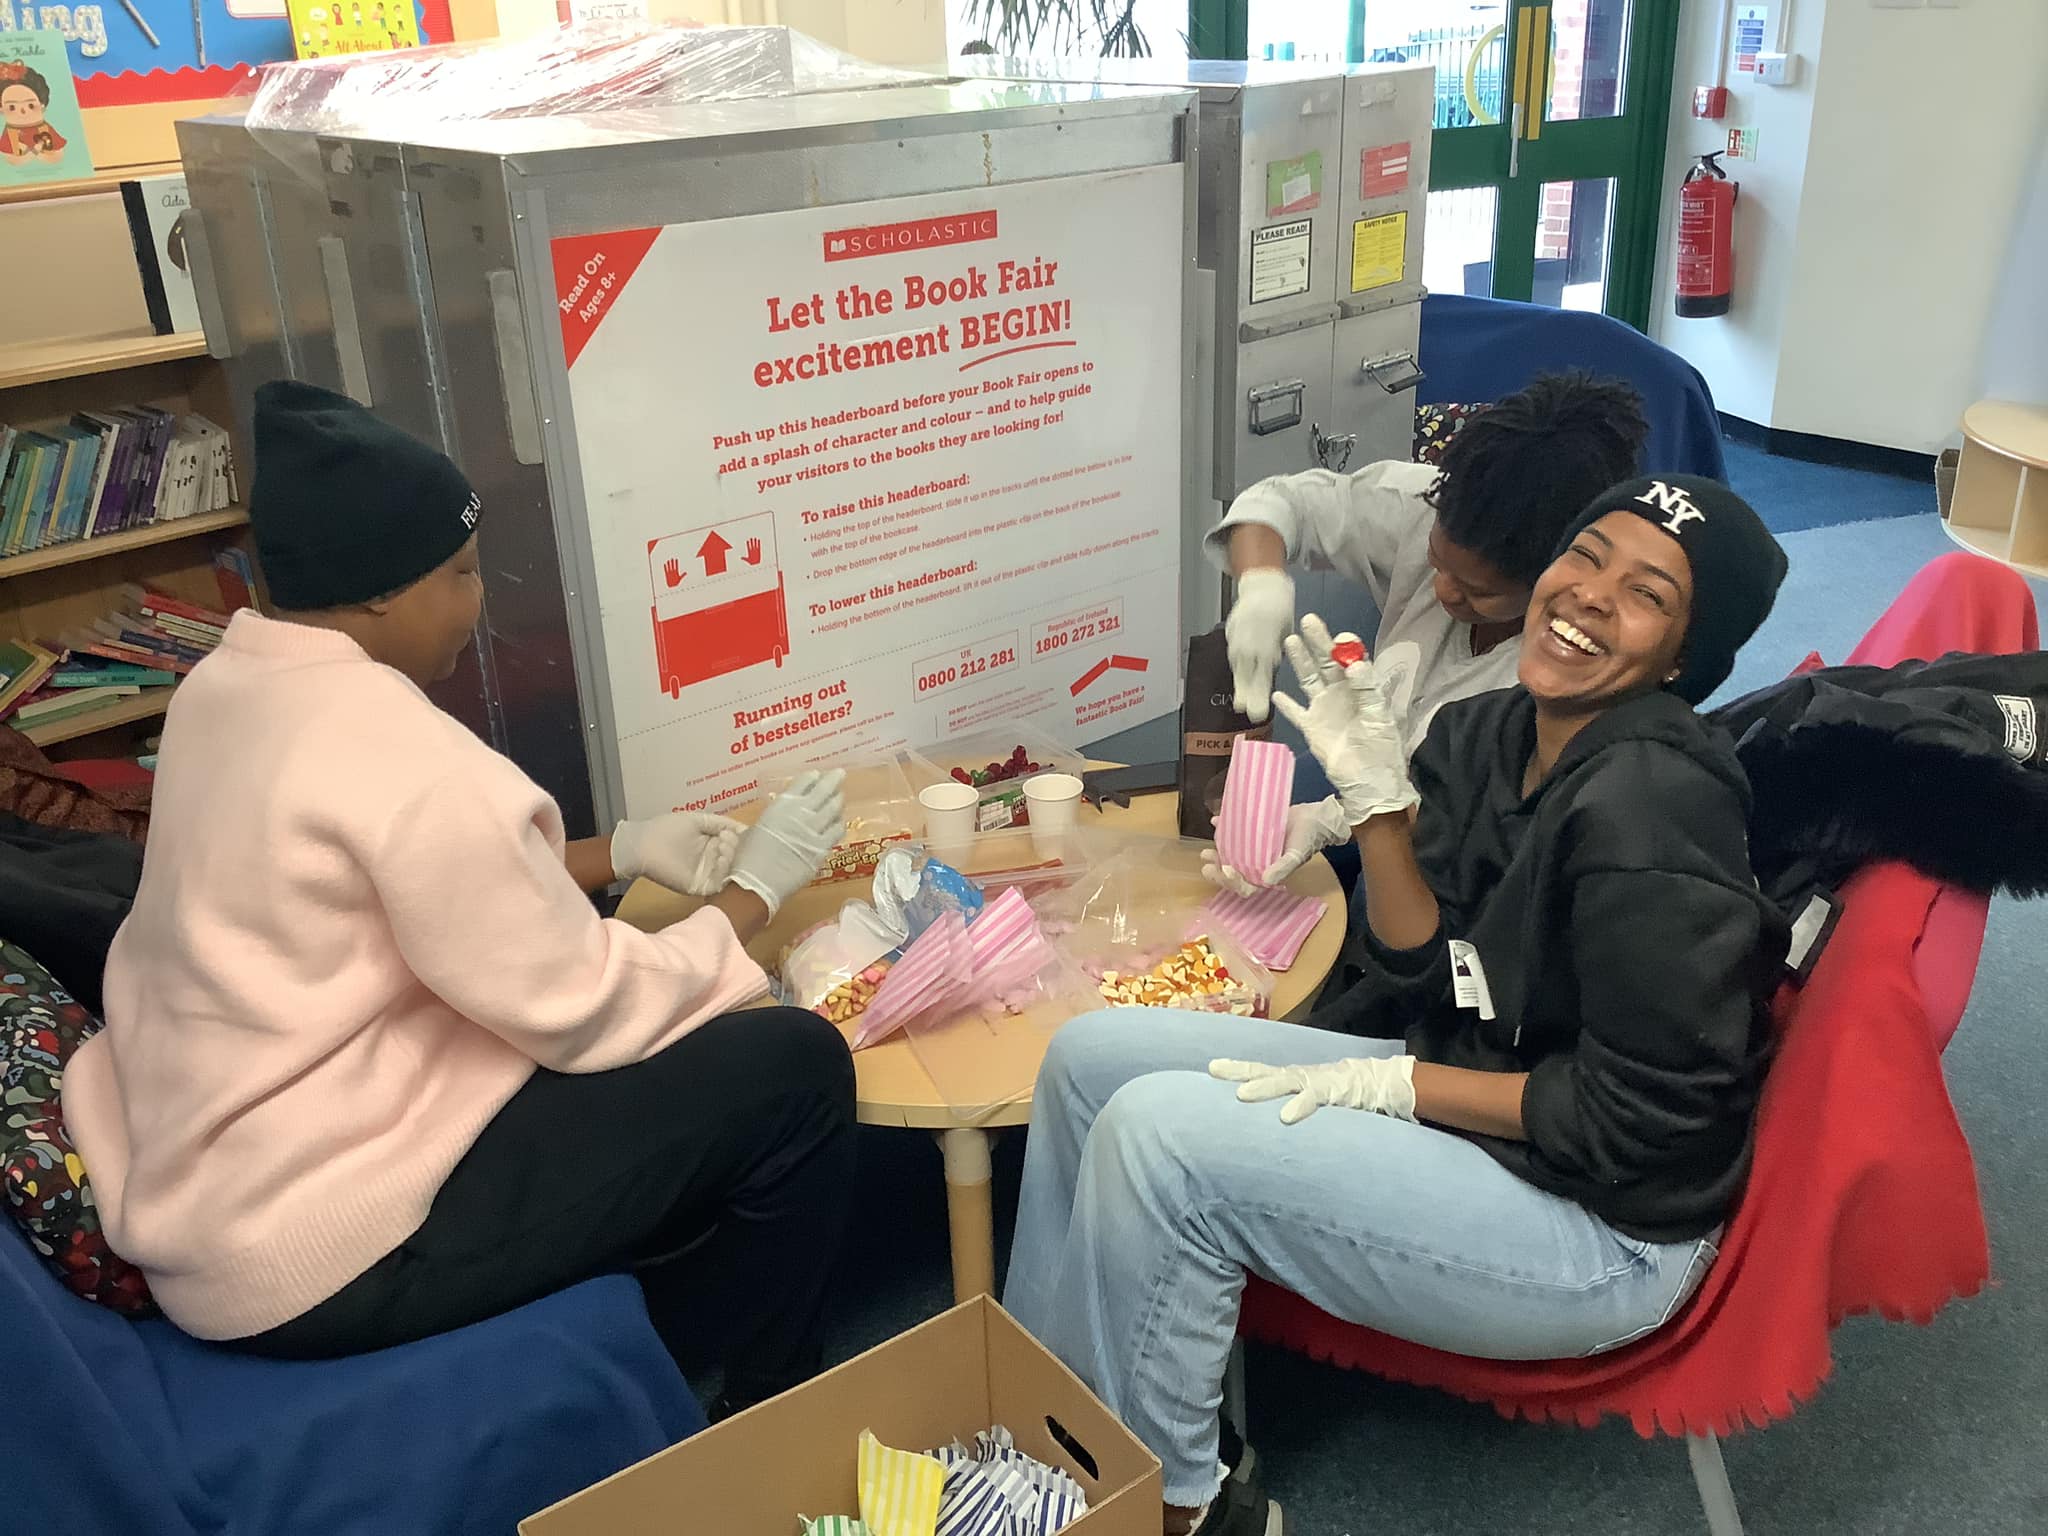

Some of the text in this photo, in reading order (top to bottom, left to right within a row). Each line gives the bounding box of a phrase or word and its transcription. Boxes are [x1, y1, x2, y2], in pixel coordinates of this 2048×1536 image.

[162, 194, 187, 208] Ada
[1364, 216, 1397, 229] SAFETY NOTICE
[849, 218, 992, 252] SCHOLASTIC
[1256, 224, 1308, 241] PLEASE READ!
[559, 251, 607, 314] Read On
[579, 270, 617, 323] Ages 8+
[767, 256, 1058, 333] Let the Book Fair
[754, 299, 1071, 387] excitement BEGIN!
[713, 361, 1094, 449] Push up this headerboard before your Book Fair opens to
[719, 457, 747, 474] add
[751, 457, 760, 467] a
[763, 444, 810, 466] splash
[814, 438, 829, 453] of
[832, 426, 898, 449] character
[901, 417, 927, 434] and
[930, 410, 972, 427] colour
[988, 400, 1010, 415] and
[1014, 397, 1026, 409] to
[1030, 391, 1055, 407] help
[1058, 383, 1091, 401] guide
[757, 410, 1064, 493] your visitors to the books they are looking for!
[801, 474, 970, 525] To raise this headerboard:
[810, 527, 841, 542] Holding
[843, 522, 856, 533] the
[857, 519, 871, 530] top
[872, 517, 881, 526] of
[882, 514, 895, 524] the
[896, 503, 944, 521] headerboard,
[946, 497, 962, 508] slide
[970, 493, 979, 502] up
[981, 491, 988, 499] in
[989, 488, 1001, 497] the
[1002, 483, 1022, 494] tracks
[1023, 478, 1038, 488] until
[1040, 475, 1050, 484] the
[1052, 470, 1073, 481] dotted
[1075, 466, 1086, 475] line
[1087, 462, 1106, 472] below
[1114, 458, 1120, 466] in
[1121, 455, 1132, 464] line
[1633, 481, 1706, 535] NY
[811, 547, 828, 558] with
[830, 543, 843, 553] the
[844, 540, 858, 550] top
[859, 537, 868, 545] of
[869, 534, 882, 543] the
[813, 567, 833, 580] Drop
[835, 563, 848, 571] the
[849, 556, 877, 570] bottom
[879, 551, 898, 562] edge
[899, 547, 907, 556] of
[908, 543, 921, 552] the
[922, 531, 968, 550] headerboard
[969, 529, 982, 539] into
[984, 524, 995, 533] the
[996, 519, 1018, 531] plastic
[1019, 514, 1031, 524] clip
[1043, 508, 1054, 517] the
[1055, 504, 1070, 514] back
[1072, 501, 1079, 510] of
[1080, 498, 1091, 507] the
[809, 560, 978, 617] To lower this headerboard:
[818, 617, 848, 633] Holding
[850, 614, 862, 625] the
[864, 607, 891, 621] bottom
[893, 603, 901, 612] of
[902, 599, 914, 609] the
[974, 580, 979, 588] it
[980, 577, 992, 586] out
[993, 574, 1001, 582] of
[1002, 571, 1013, 580] the
[1014, 564, 1035, 577] plastic
[1037, 560, 1049, 570] clip
[1050, 557, 1062, 566] and
[1063, 552, 1078, 563] slide
[1079, 548, 1092, 557] fully
[1093, 544, 1111, 553] down
[1112, 537, 1129, 547] along
[1130, 534, 1140, 542] the
[1036, 615, 1120, 655] 1800 272 321
[1047, 607, 1108, 632] Republic of Ireland
[918, 648, 1015, 691] 0800 212 281
[960, 648, 971, 659] UK
[733, 679, 847, 728] Running out
[1075, 705, 1087, 715] We
[1088, 698, 1106, 711] hope
[1107, 694, 1121, 705] you
[1123, 687, 1139, 697] have
[1076, 695, 1145, 726] fantastic Book Fair!
[731, 700, 854, 755] of bestsellers?
[1196, 738, 1220, 749] PICK
[829, 851, 860, 870] Fried
